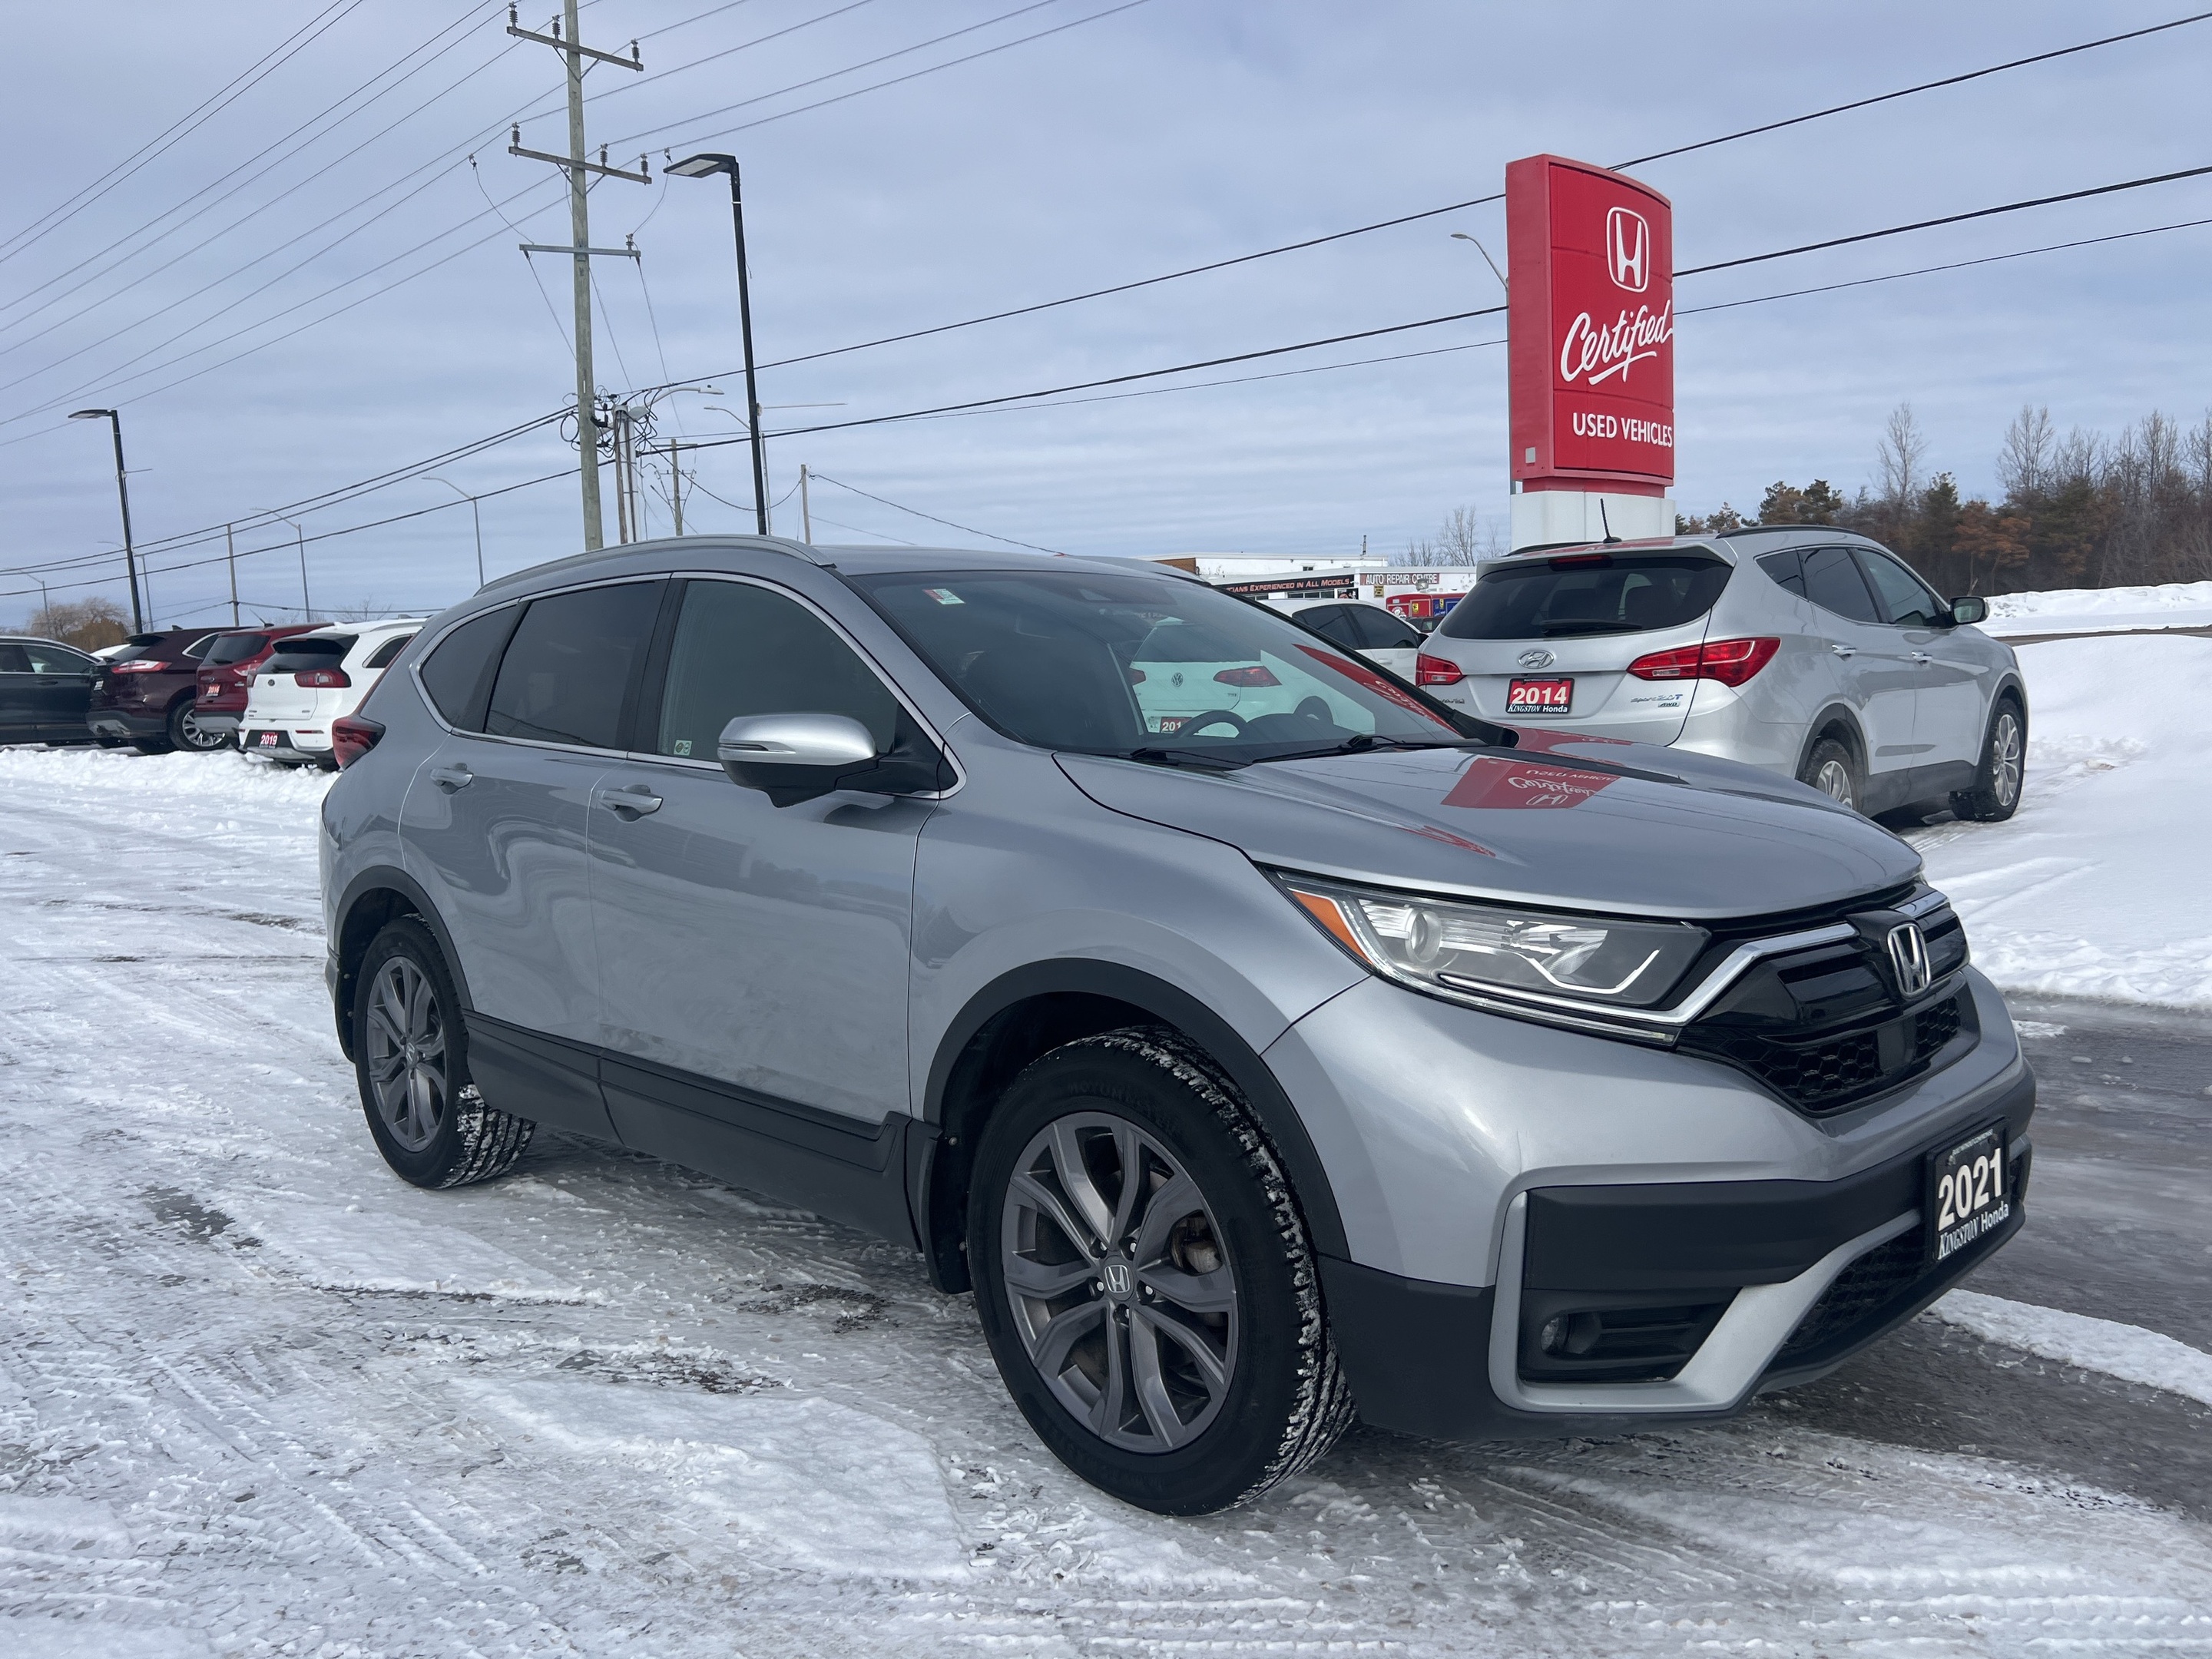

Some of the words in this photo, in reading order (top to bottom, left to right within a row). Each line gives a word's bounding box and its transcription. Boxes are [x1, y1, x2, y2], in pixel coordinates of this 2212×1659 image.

[1561, 300, 1673, 384] Certified
[1573, 412, 1617, 438] USED
[1621, 417, 1672, 448] VEHICLES
[1366, 575, 1383, 584] AUTO
[1386, 574, 1409, 584] REPAIR
[1512, 687, 1567, 704] 2014
[1508, 704, 1541, 713] KINGSTON
[1161, 721, 1181, 731] 201
[260, 734, 277, 745] 2019
[1938, 1147, 2002, 1232] 2021
[1937, 1217, 1979, 1261] KINGSTON
[1981, 1200, 2009, 1233] Honda
